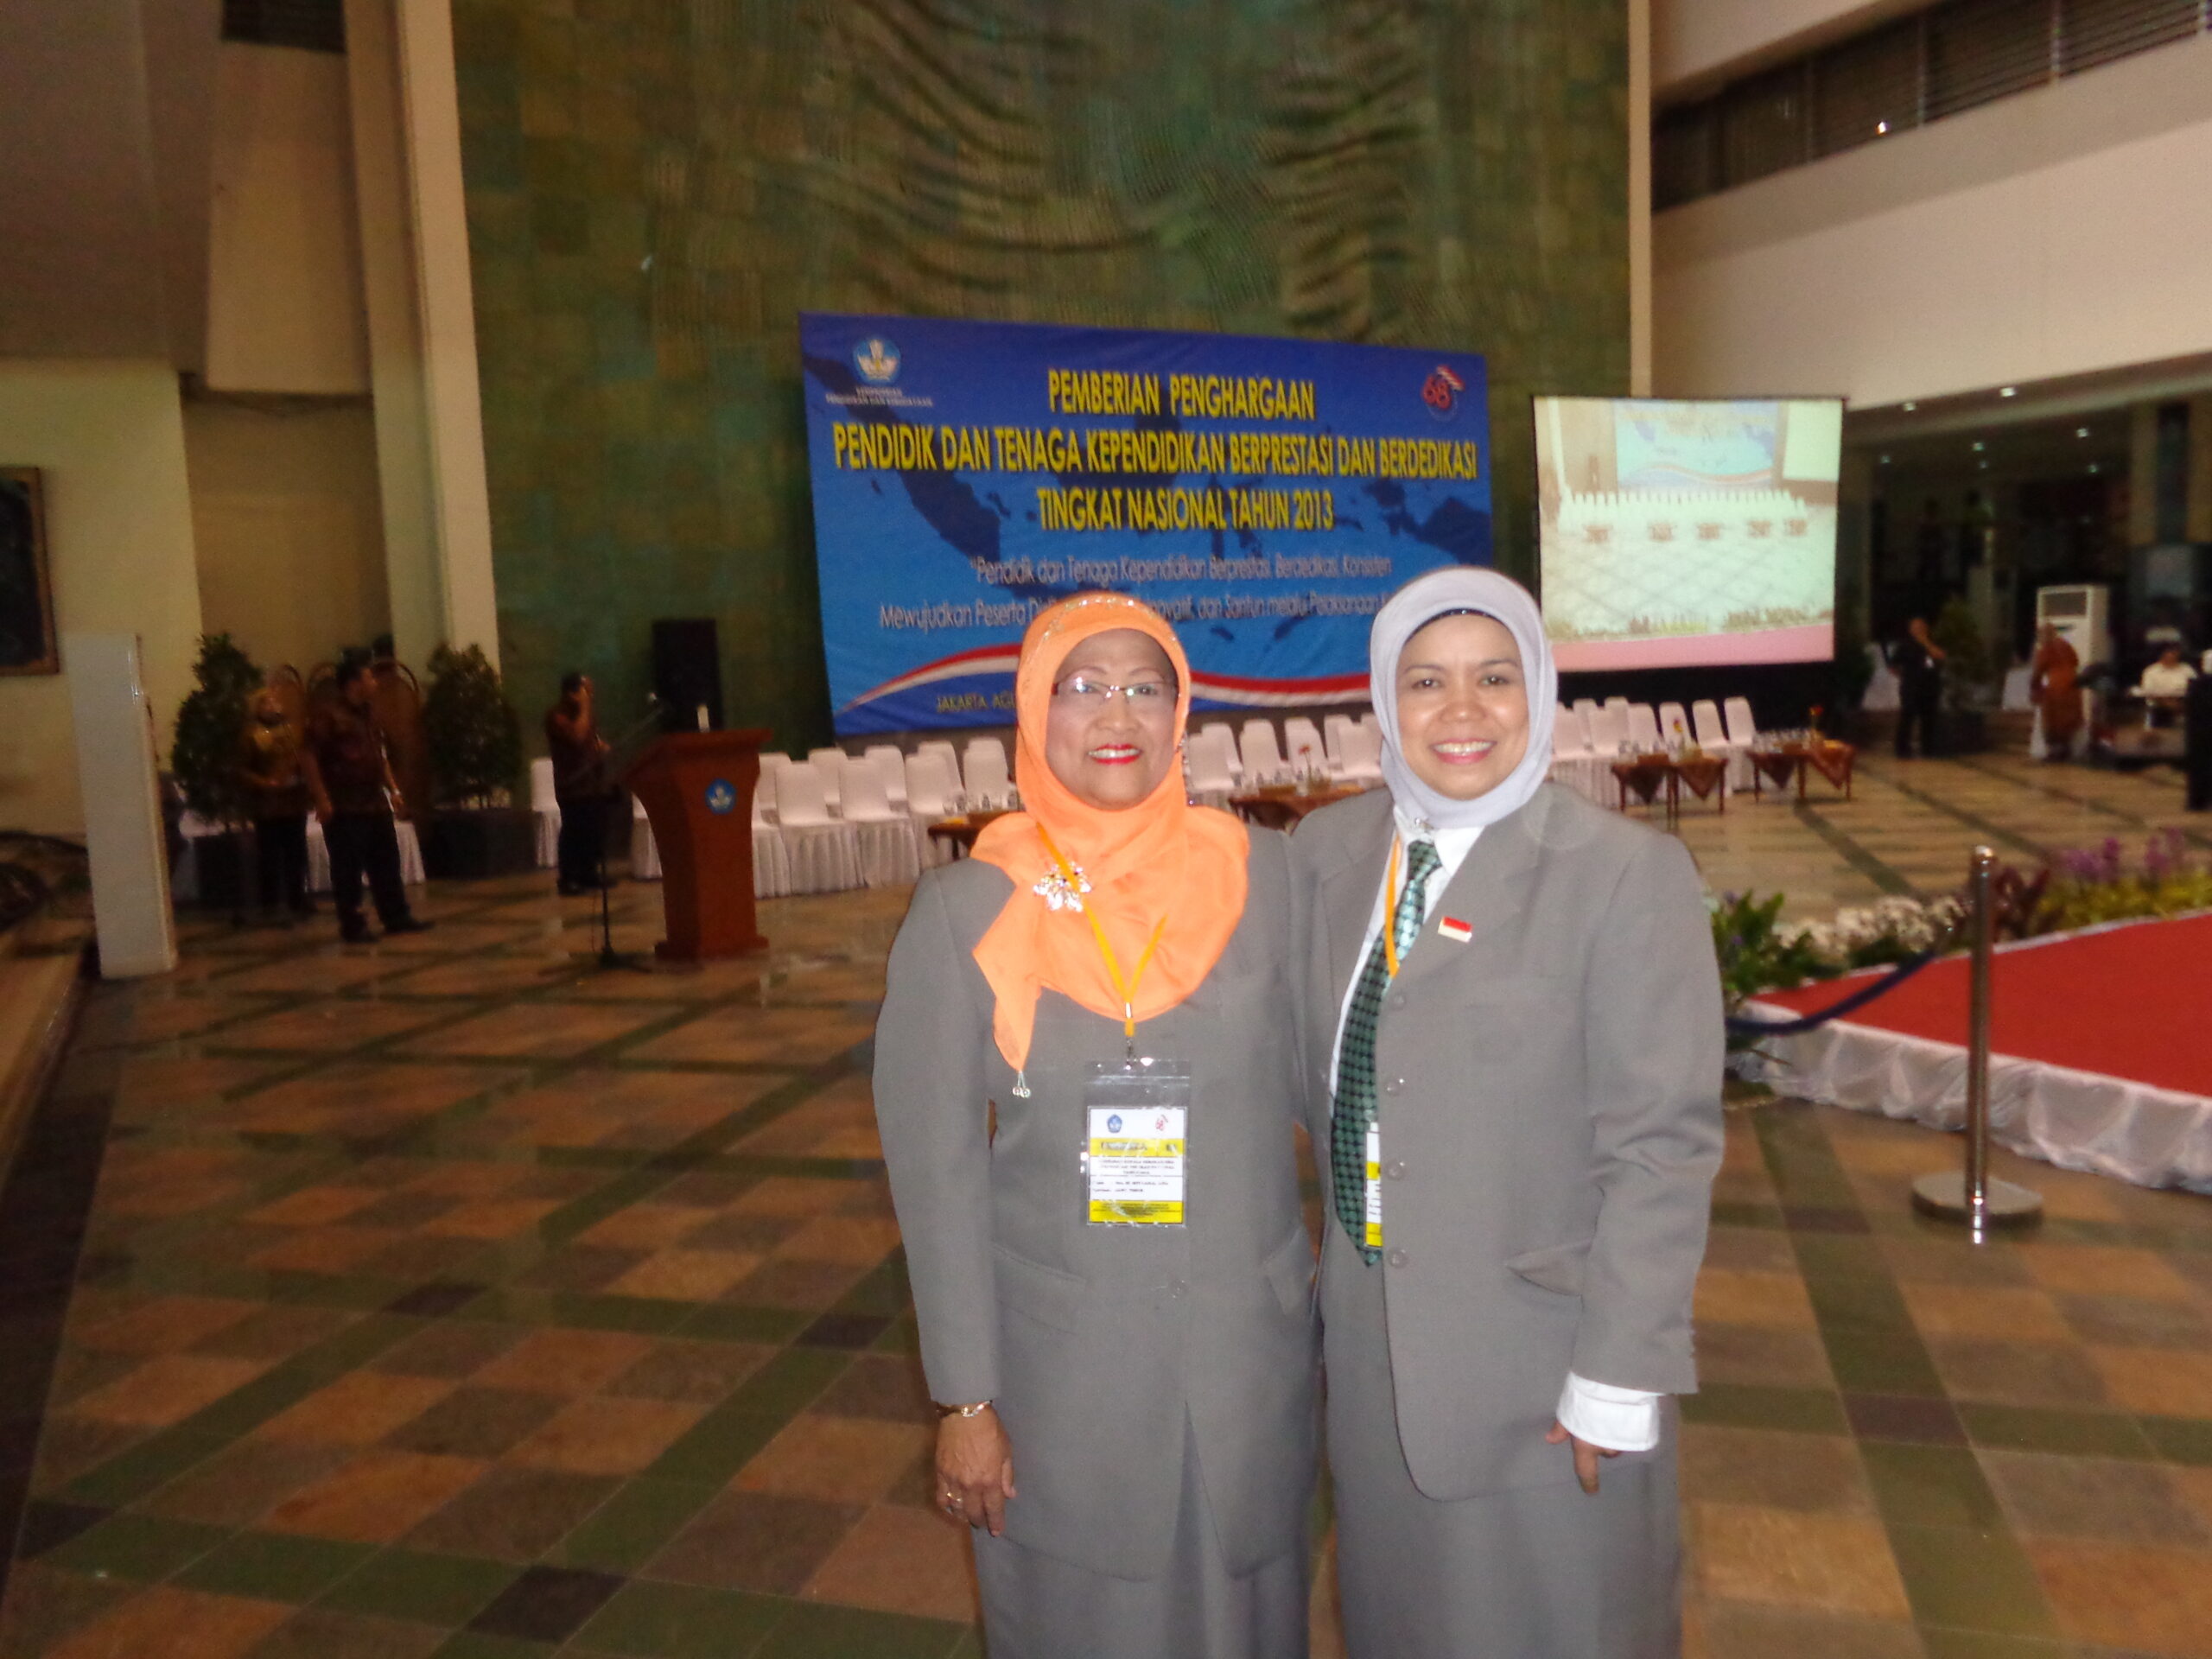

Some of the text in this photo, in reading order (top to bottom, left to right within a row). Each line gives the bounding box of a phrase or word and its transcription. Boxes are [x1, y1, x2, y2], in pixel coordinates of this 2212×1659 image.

[1049, 370, 1314, 419] PEMBERIAN PENGHARGAAN
[834, 423, 1478, 480] PENDIDIK DAN TENAGA KEPENDIDIKAN BERPRESTASI DAN BERDEDIKASI
[1037, 486, 1335, 531] TINGKAT NASIONAL TAHUN 2013
